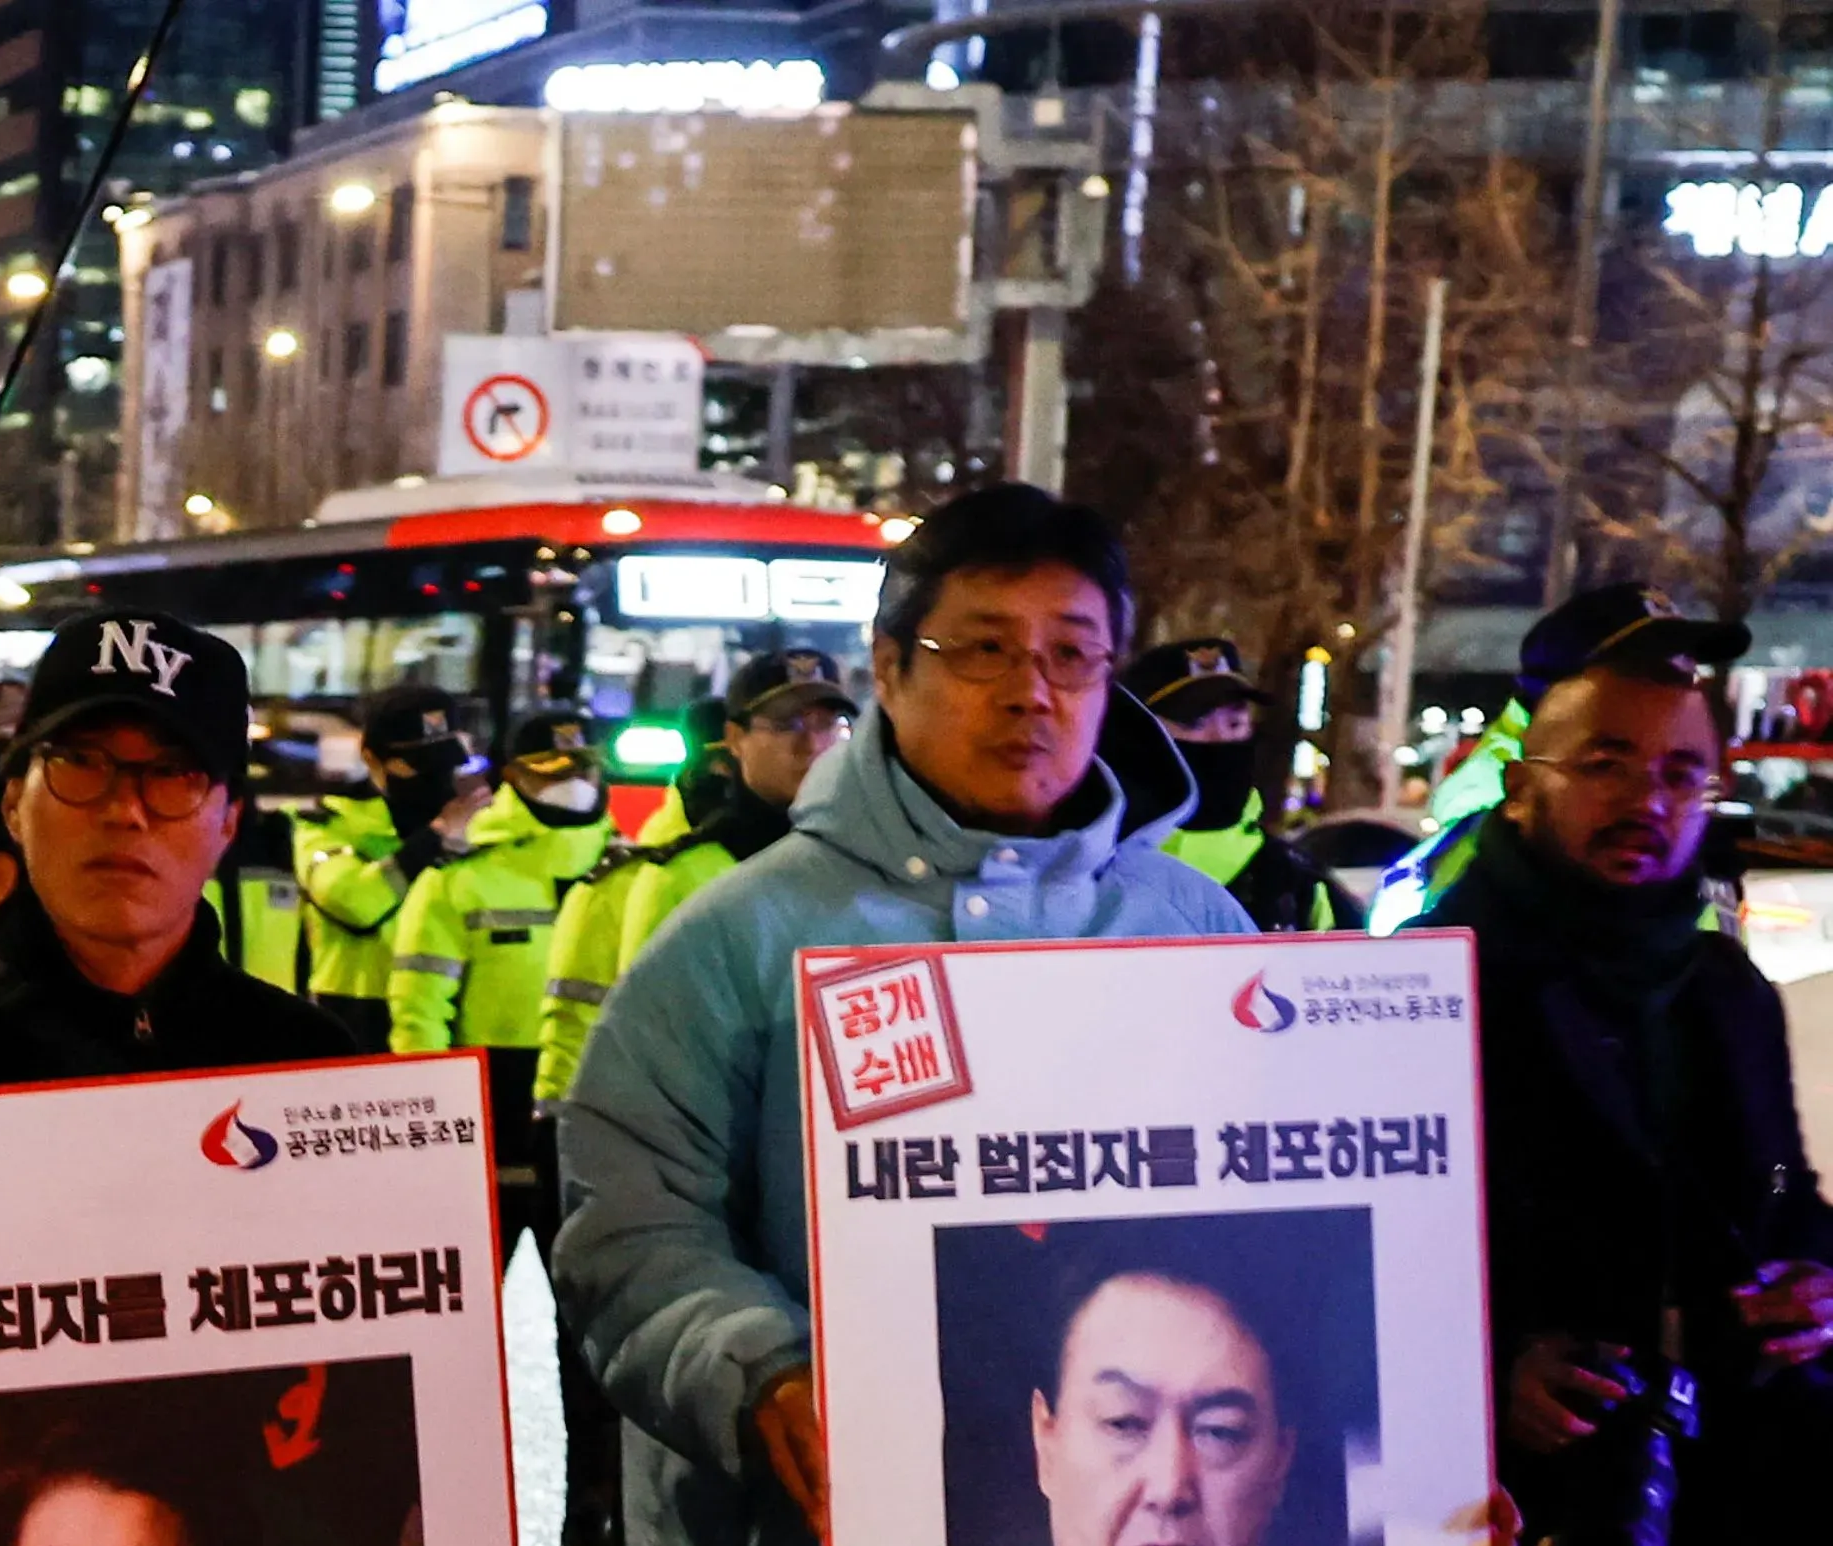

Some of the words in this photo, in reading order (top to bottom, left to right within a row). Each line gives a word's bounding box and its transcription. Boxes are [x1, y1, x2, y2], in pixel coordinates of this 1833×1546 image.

[90, 619, 193, 698] NY
[836, 972, 927, 1040] 공개
[851, 1031, 942, 1097] 수배
[284, 1117, 478, 1161] 공공연대노동조합
[845, 1136, 960, 1201] 내란
[977, 1126, 1198, 1196] 범죄자를
[1218, 1115, 1448, 1184] 체포하라!
[188, 1247, 463, 1333] 체포하라!
